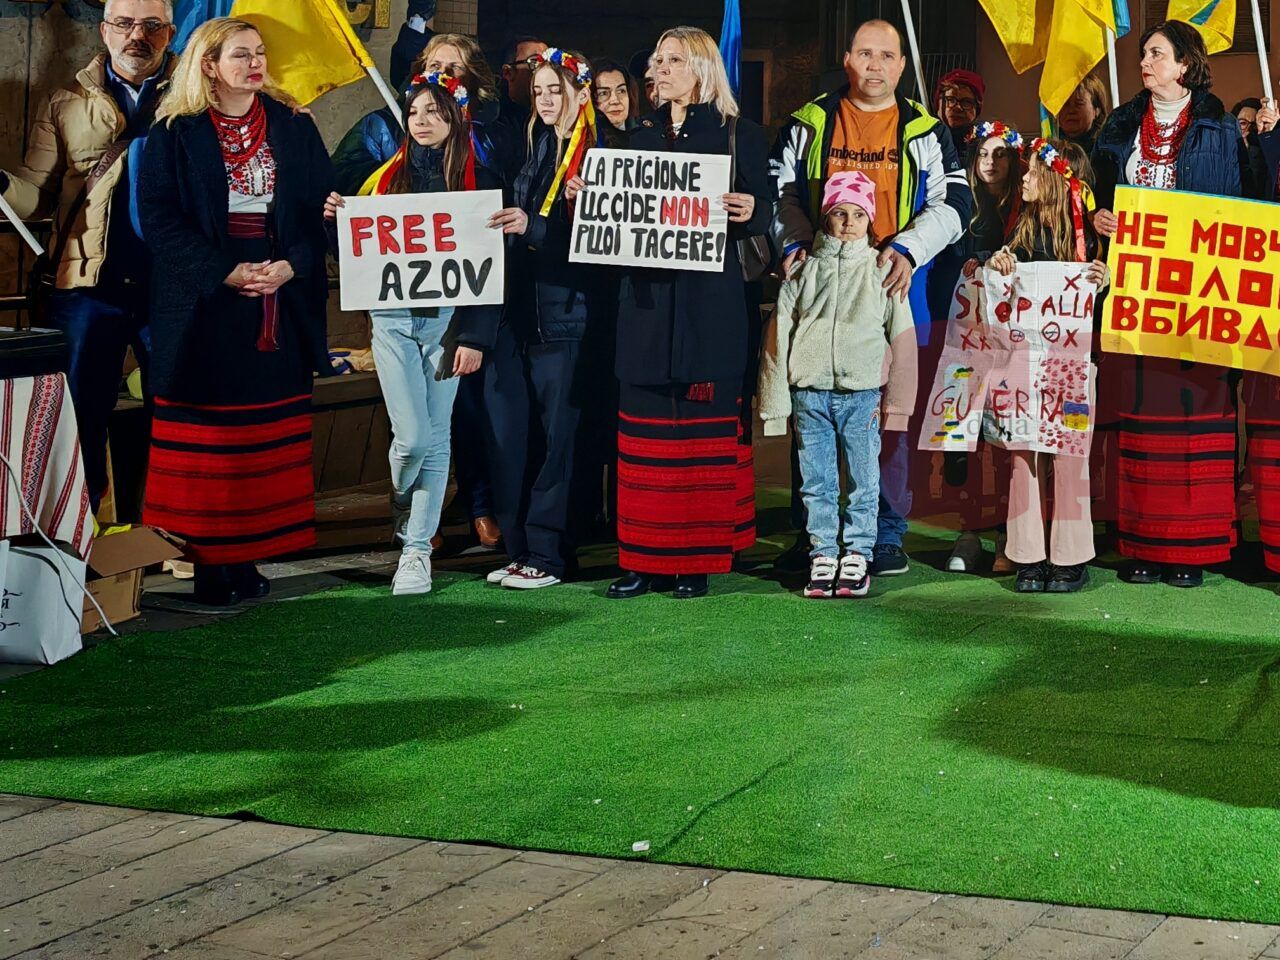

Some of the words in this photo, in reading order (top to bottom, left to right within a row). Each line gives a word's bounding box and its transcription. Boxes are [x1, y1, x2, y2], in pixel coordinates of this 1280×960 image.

[584, 156, 606, 187] LA
[611, 155, 701, 192] PRIGIONE
[830, 145, 886, 163] mberland
[580, 190, 658, 224] UCCIDE
[660, 195, 710, 228] NON
[350, 212, 457, 257] FREE
[574, 224, 622, 256] PUOI
[630, 227, 726, 263] TACERE!
[1117, 210, 1168, 249] НЕ
[378, 257, 494, 301] AZOV
[955, 279, 1033, 325] STOP
[1041, 292, 1093, 320] ALLA
[931, 385, 1065, 423] GUERRA
